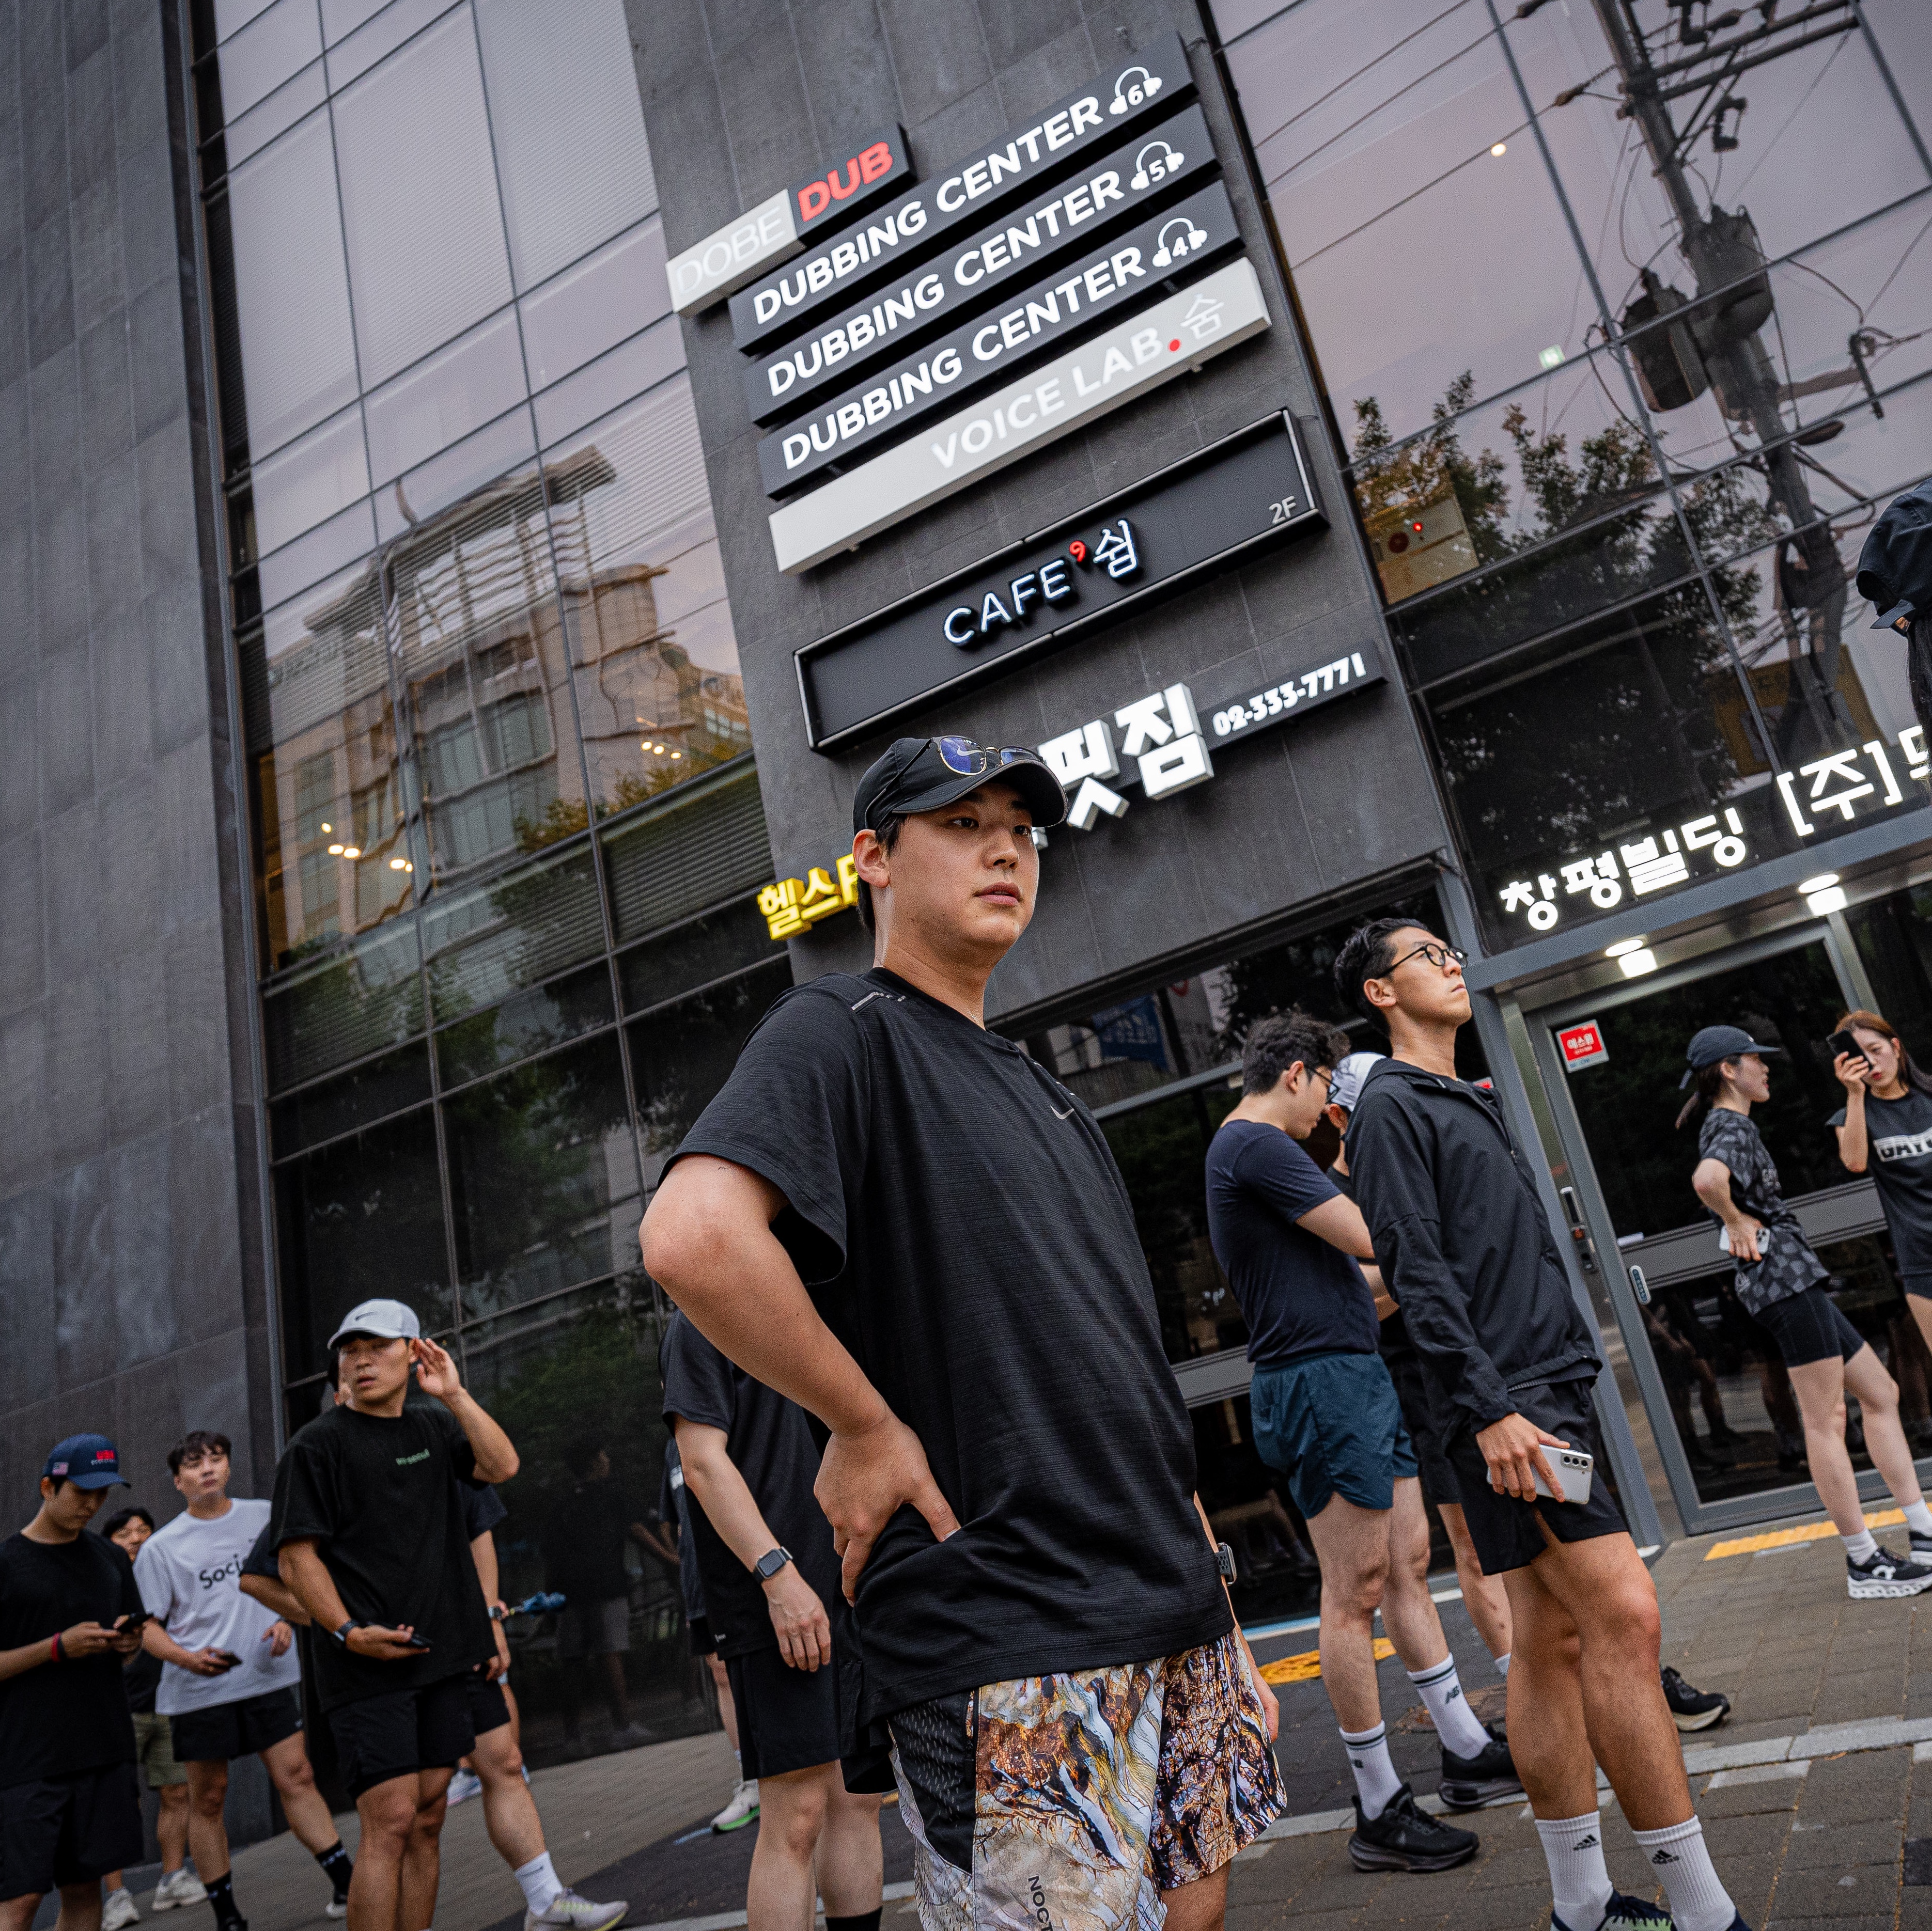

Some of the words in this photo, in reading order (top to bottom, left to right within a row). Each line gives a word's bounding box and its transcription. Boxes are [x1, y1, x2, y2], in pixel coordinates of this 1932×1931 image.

[676, 207, 786, 293] DOBE
[797, 142, 893, 222] DUB
[754, 200, 926, 323] DUBBING
[937, 96, 1102, 211] CENTER
[1128, 84, 1144, 105] 6
[768, 274, 944, 396] DUBBING
[955, 171, 1125, 286] CENTER
[1149, 159, 1165, 182] 5
[783, 348, 962, 468] DUBBING
[972, 246, 1147, 360] CENTER
[932, 377, 1065, 468] VOICE
[1269, 495, 1297, 525] 2F
[1033, 682, 1214, 850] 핏짐
[1212, 652, 1366, 736] 02-333-7771
[1500, 807, 1747, 931] 창평빌딩
[199, 1553, 242, 1590] Soci
